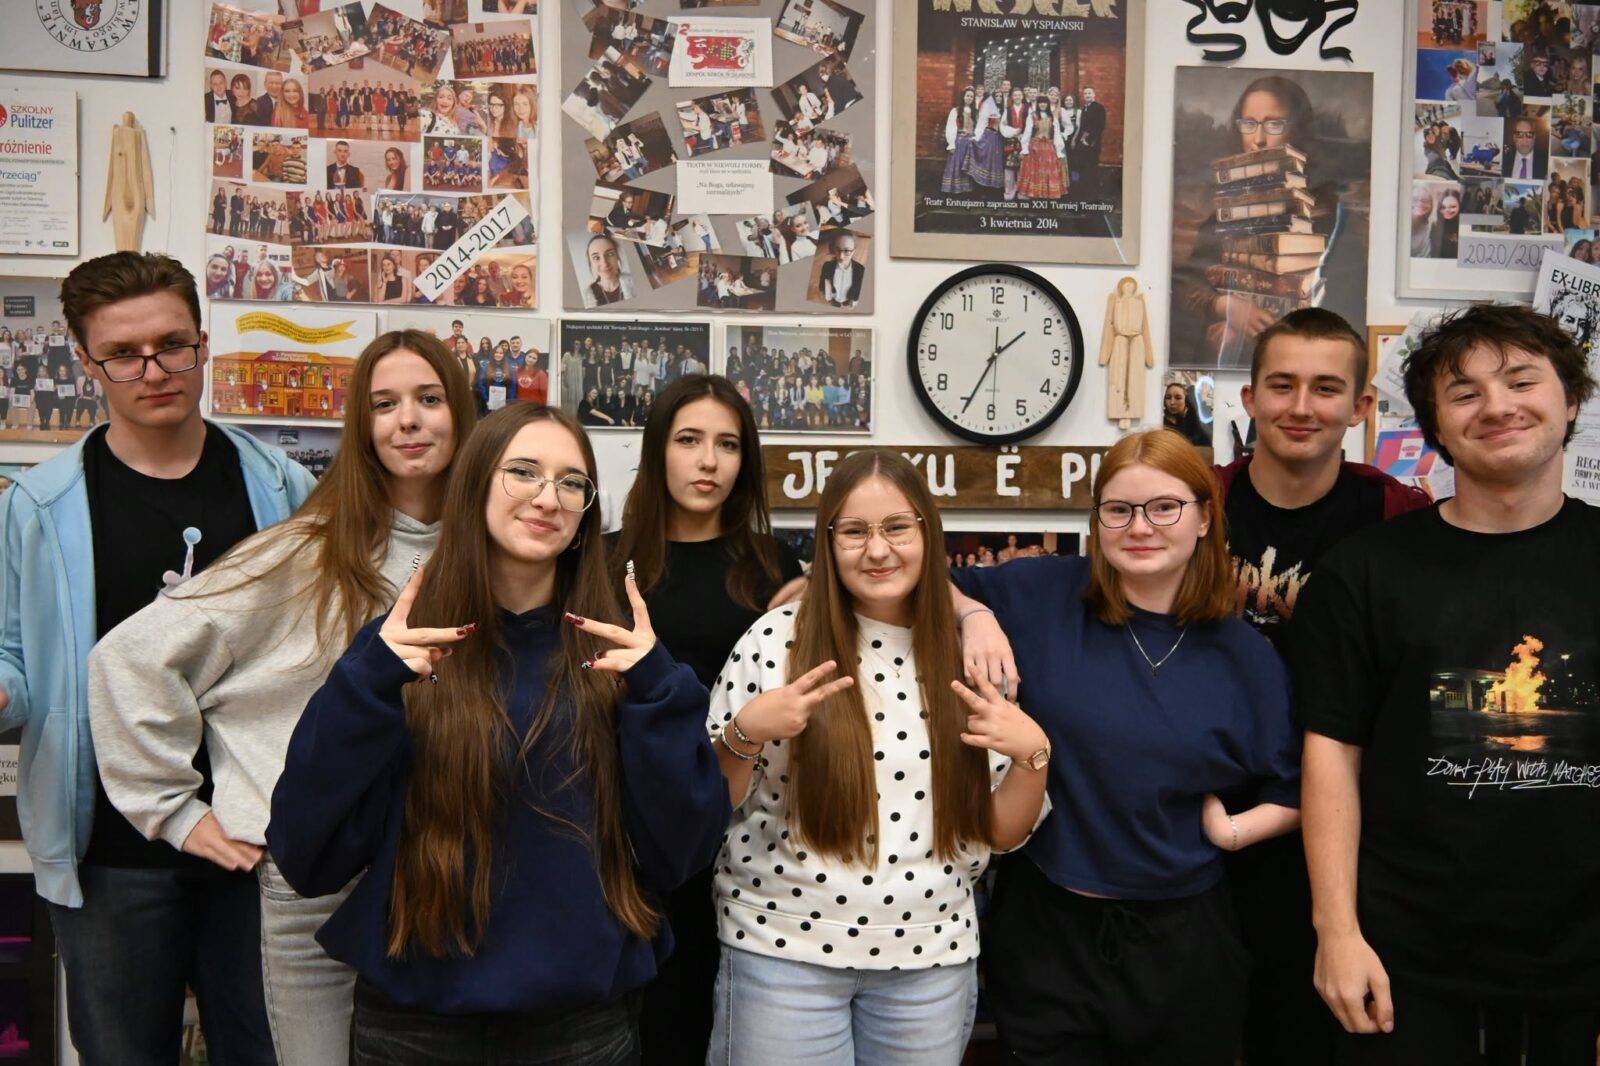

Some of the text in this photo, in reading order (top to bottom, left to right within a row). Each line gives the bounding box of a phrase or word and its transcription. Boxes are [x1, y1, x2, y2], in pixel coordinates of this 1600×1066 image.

[11, 105, 54, 115] SZKOLNY
[11, 113, 54, 129] Pulitzer
[924, 197, 943, 206] Teatr
[946, 198, 985, 209] Entuzjazm
[986, 201, 1018, 210] zaprasza
[1032, 200, 1048, 209] XXI
[1050, 201, 1078, 212] Turniej
[1080, 201, 1114, 213] Teatralny
[980, 216, 1058, 229] 3 kwietnia 2014
[425, 206, 512, 290] 2014-2017
[1463, 243, 1554, 269] 2020/20
[962, 294, 973, 312] 11
[991, 286, 1005, 304] 12
[1023, 295, 1028, 312] 1
[940, 313, 954, 330] 10
[1043, 317, 1052, 335] 2
[928, 344, 937, 361] 9
[1051, 349, 1060, 366] 3
[937, 373, 948, 391] 8
[1039, 378, 1050, 396] 4
[986, 404, 996, 421] 6
[1016, 399, 1027, 416] 5
[996, 445, 1021, 496] Ë
